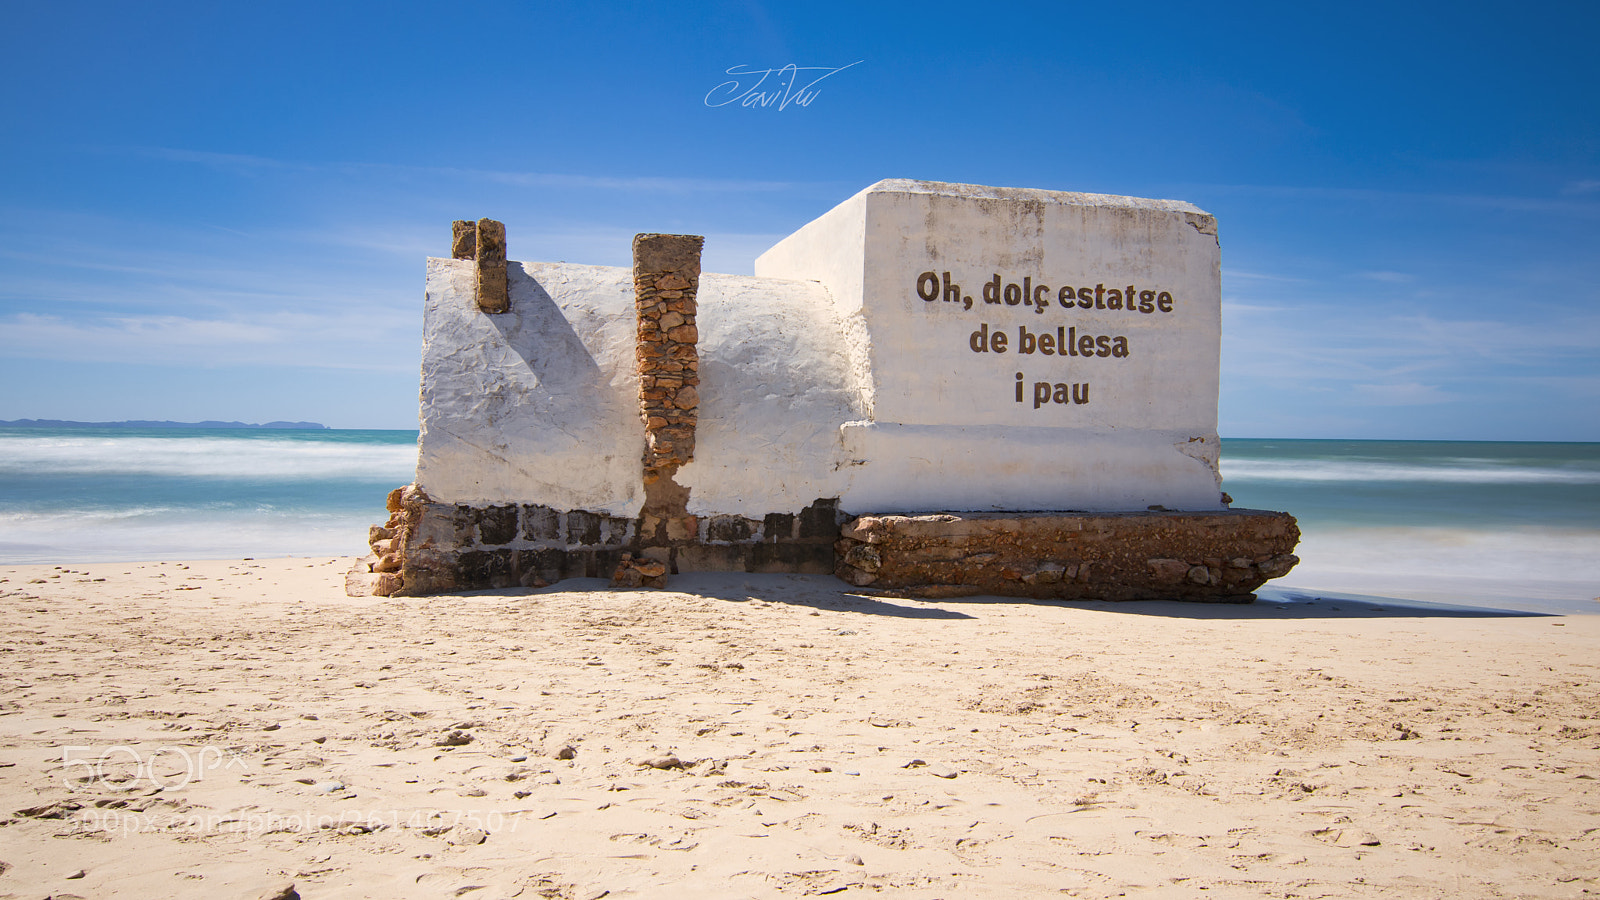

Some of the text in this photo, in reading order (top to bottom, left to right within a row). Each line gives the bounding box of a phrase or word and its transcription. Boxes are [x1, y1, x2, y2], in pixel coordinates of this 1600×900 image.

[916, 271, 1173, 314] Oh, dolç estatge
[969, 323, 1130, 358] de bellesa
[1015, 372, 1090, 409] i pau
